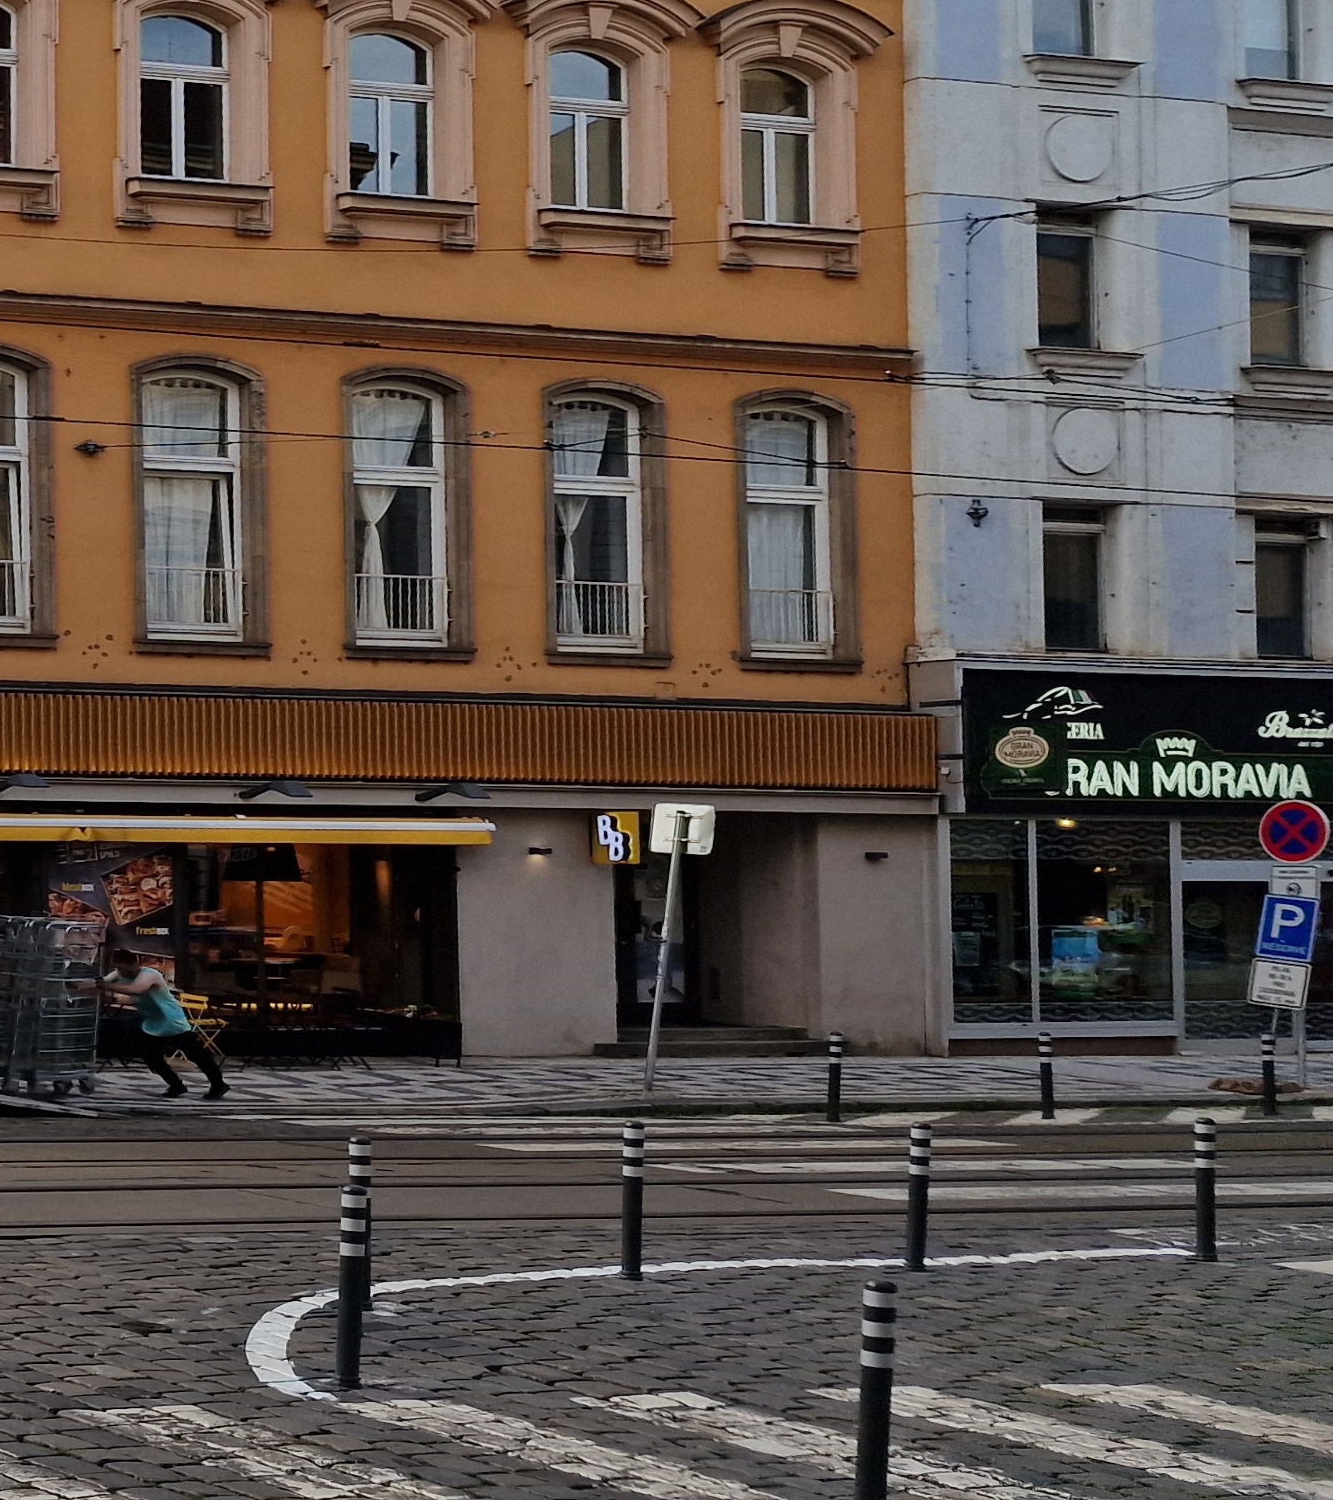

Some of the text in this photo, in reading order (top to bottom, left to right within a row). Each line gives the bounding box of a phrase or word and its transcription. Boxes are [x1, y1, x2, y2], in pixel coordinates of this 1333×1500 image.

[1066, 722, 1105, 739] ERIA
[1044, 758, 1313, 799] RAN MORAVIA
[1270, 902, 1306, 939] P
